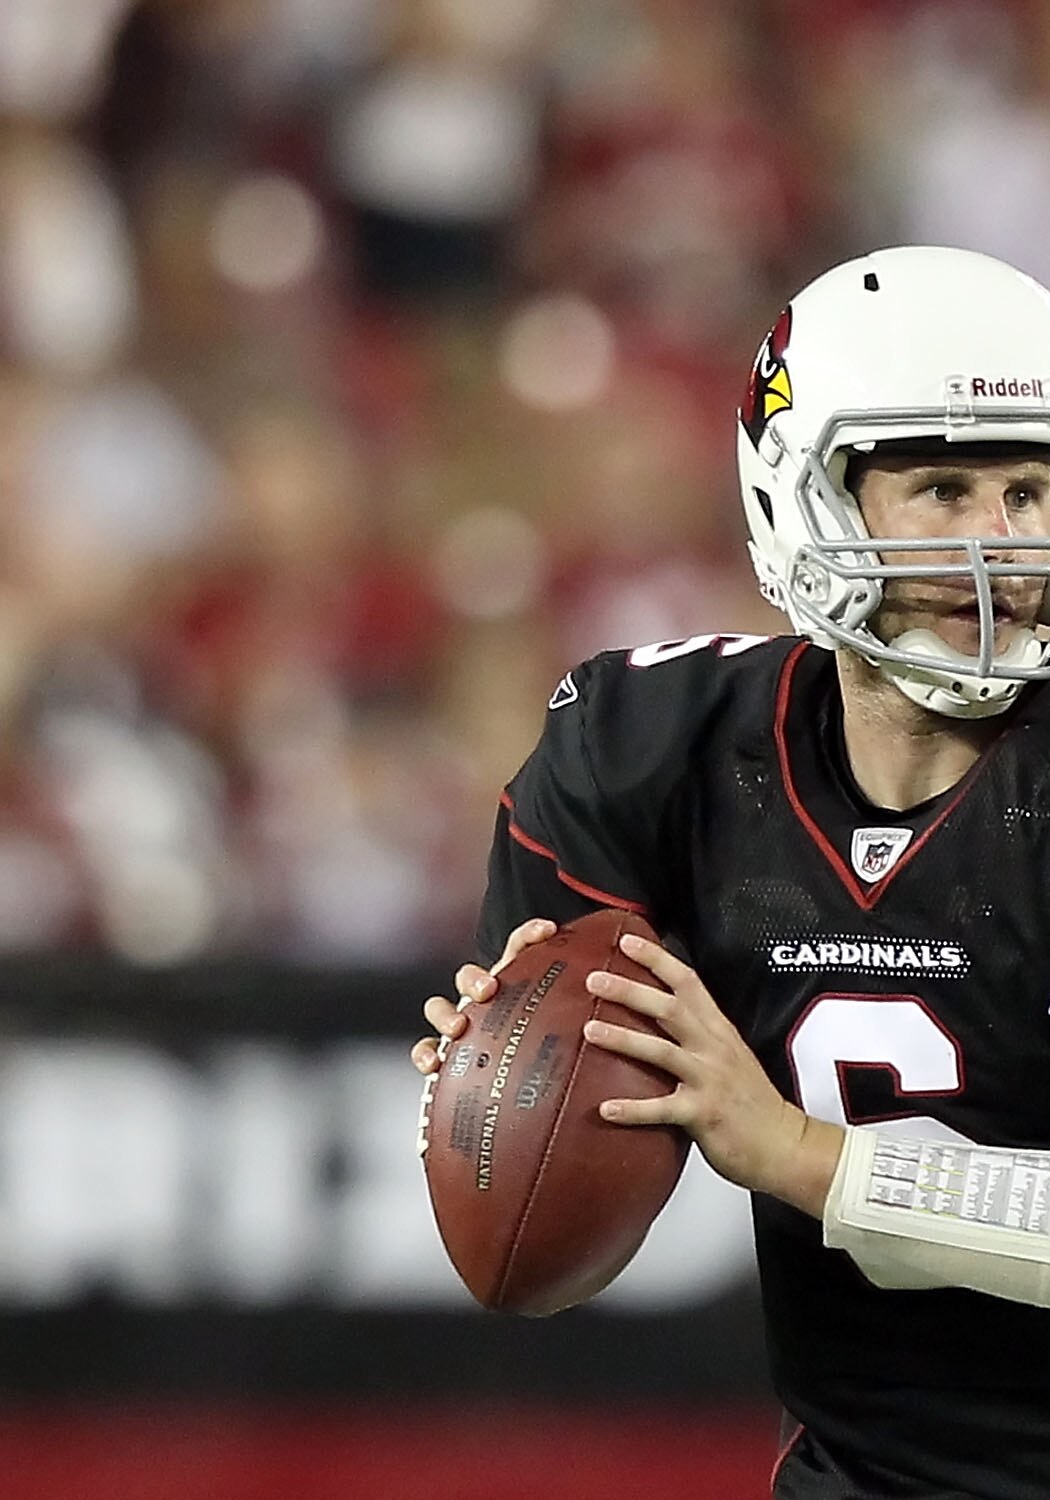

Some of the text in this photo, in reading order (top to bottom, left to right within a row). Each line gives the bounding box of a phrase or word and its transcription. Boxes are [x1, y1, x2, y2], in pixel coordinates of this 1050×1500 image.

[971, 377, 1044, 398] Riddell
[771, 943, 962, 968] CARDINALS
[476, 1104, 500, 1191] NATIONAL
[489, 1016, 531, 1100] FOOTBALL
[785, 991, 966, 1147] 6
